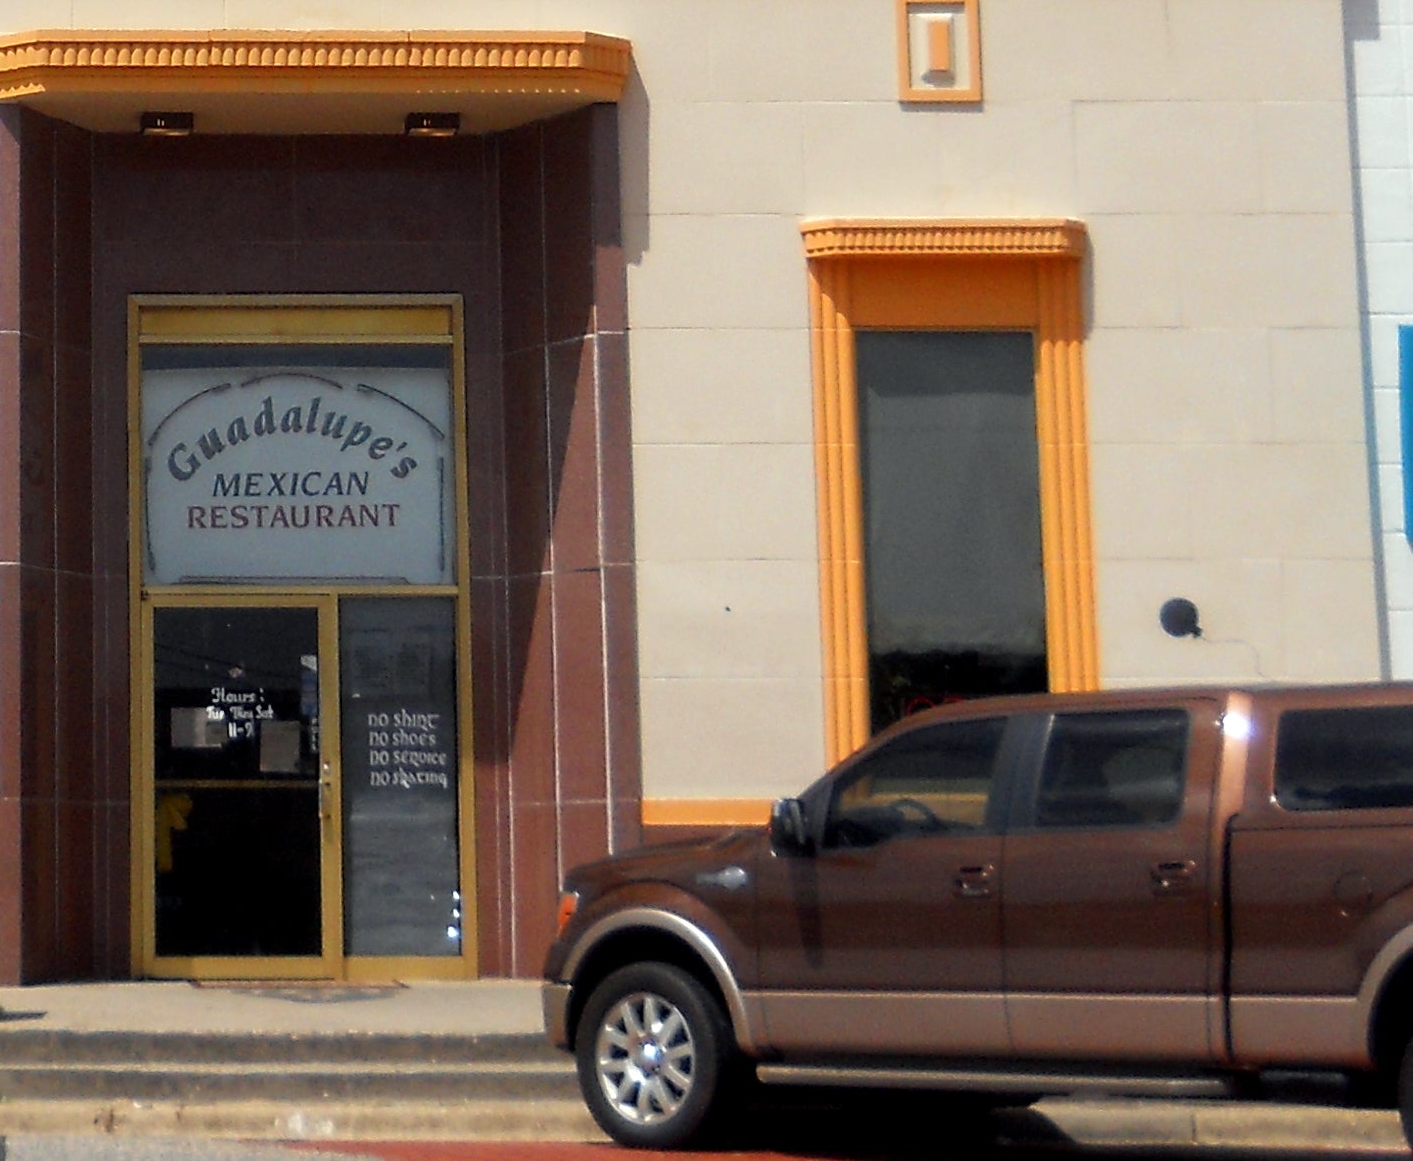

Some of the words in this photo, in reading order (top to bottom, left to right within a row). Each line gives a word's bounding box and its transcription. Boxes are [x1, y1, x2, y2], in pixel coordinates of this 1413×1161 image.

[167, 396, 417, 481] Guadalupe's
[212, 471, 368, 497] MEXICAN
[187, 503, 400, 529] RESTAURANT
[255, 704, 274, 719] Sat
